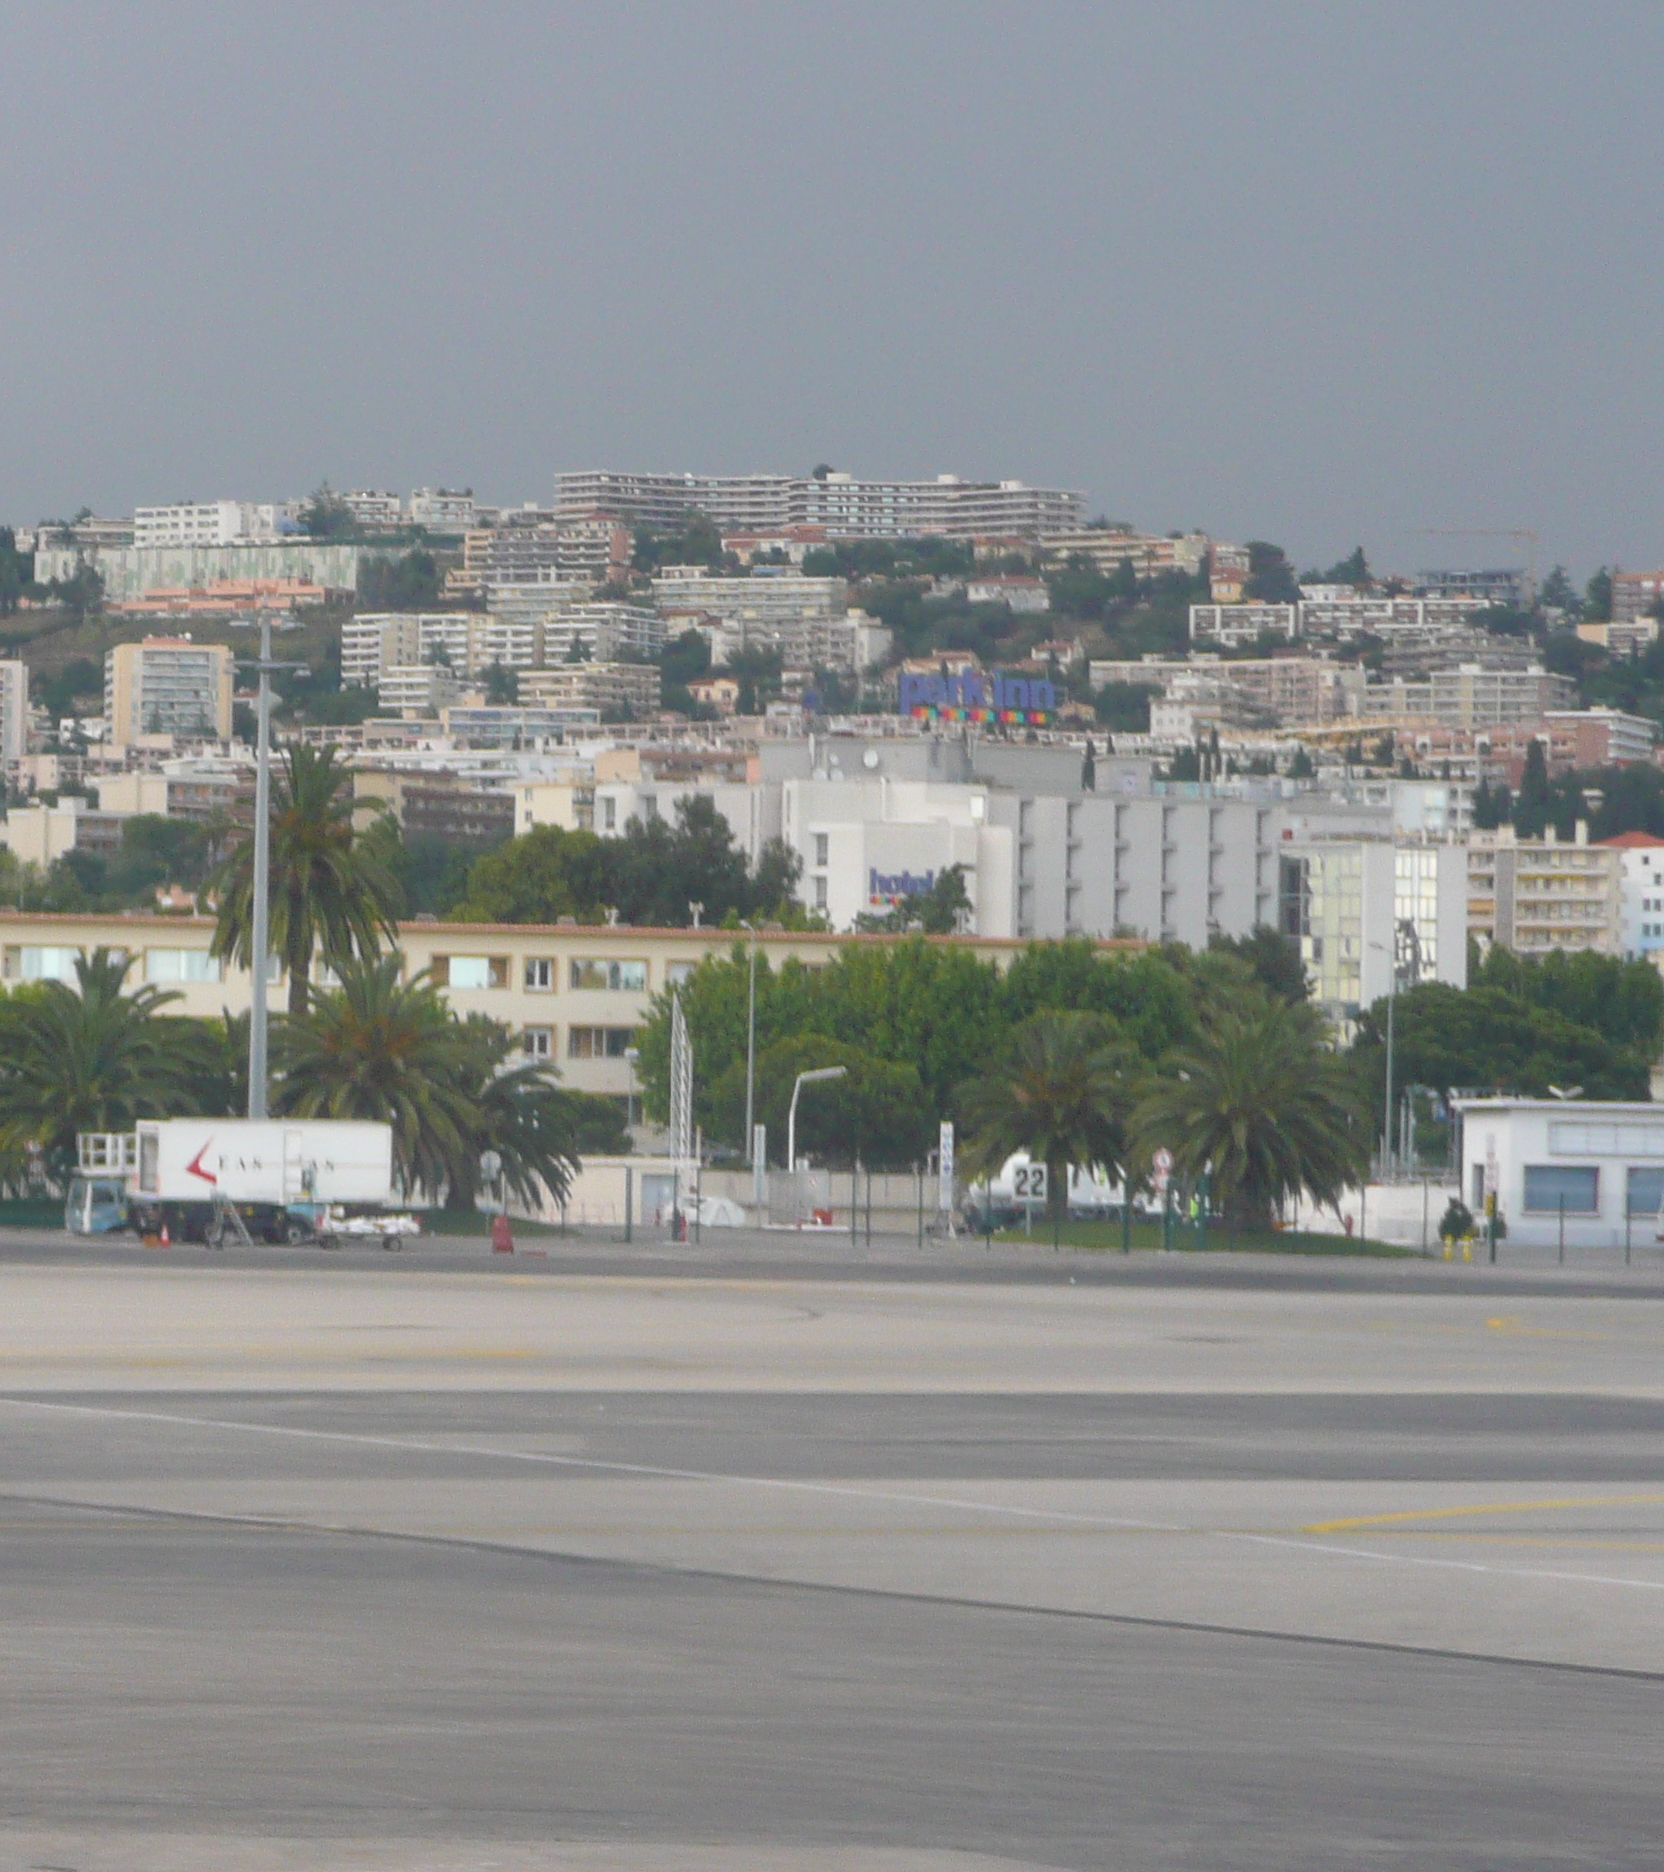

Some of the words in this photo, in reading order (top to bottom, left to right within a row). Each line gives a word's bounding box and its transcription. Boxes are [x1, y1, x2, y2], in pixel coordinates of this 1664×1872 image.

[899, 667, 988, 715] park
[992, 668, 1056, 710] inn
[869, 866, 933, 896] hotel
[1015, 1167, 1044, 1197] 22
